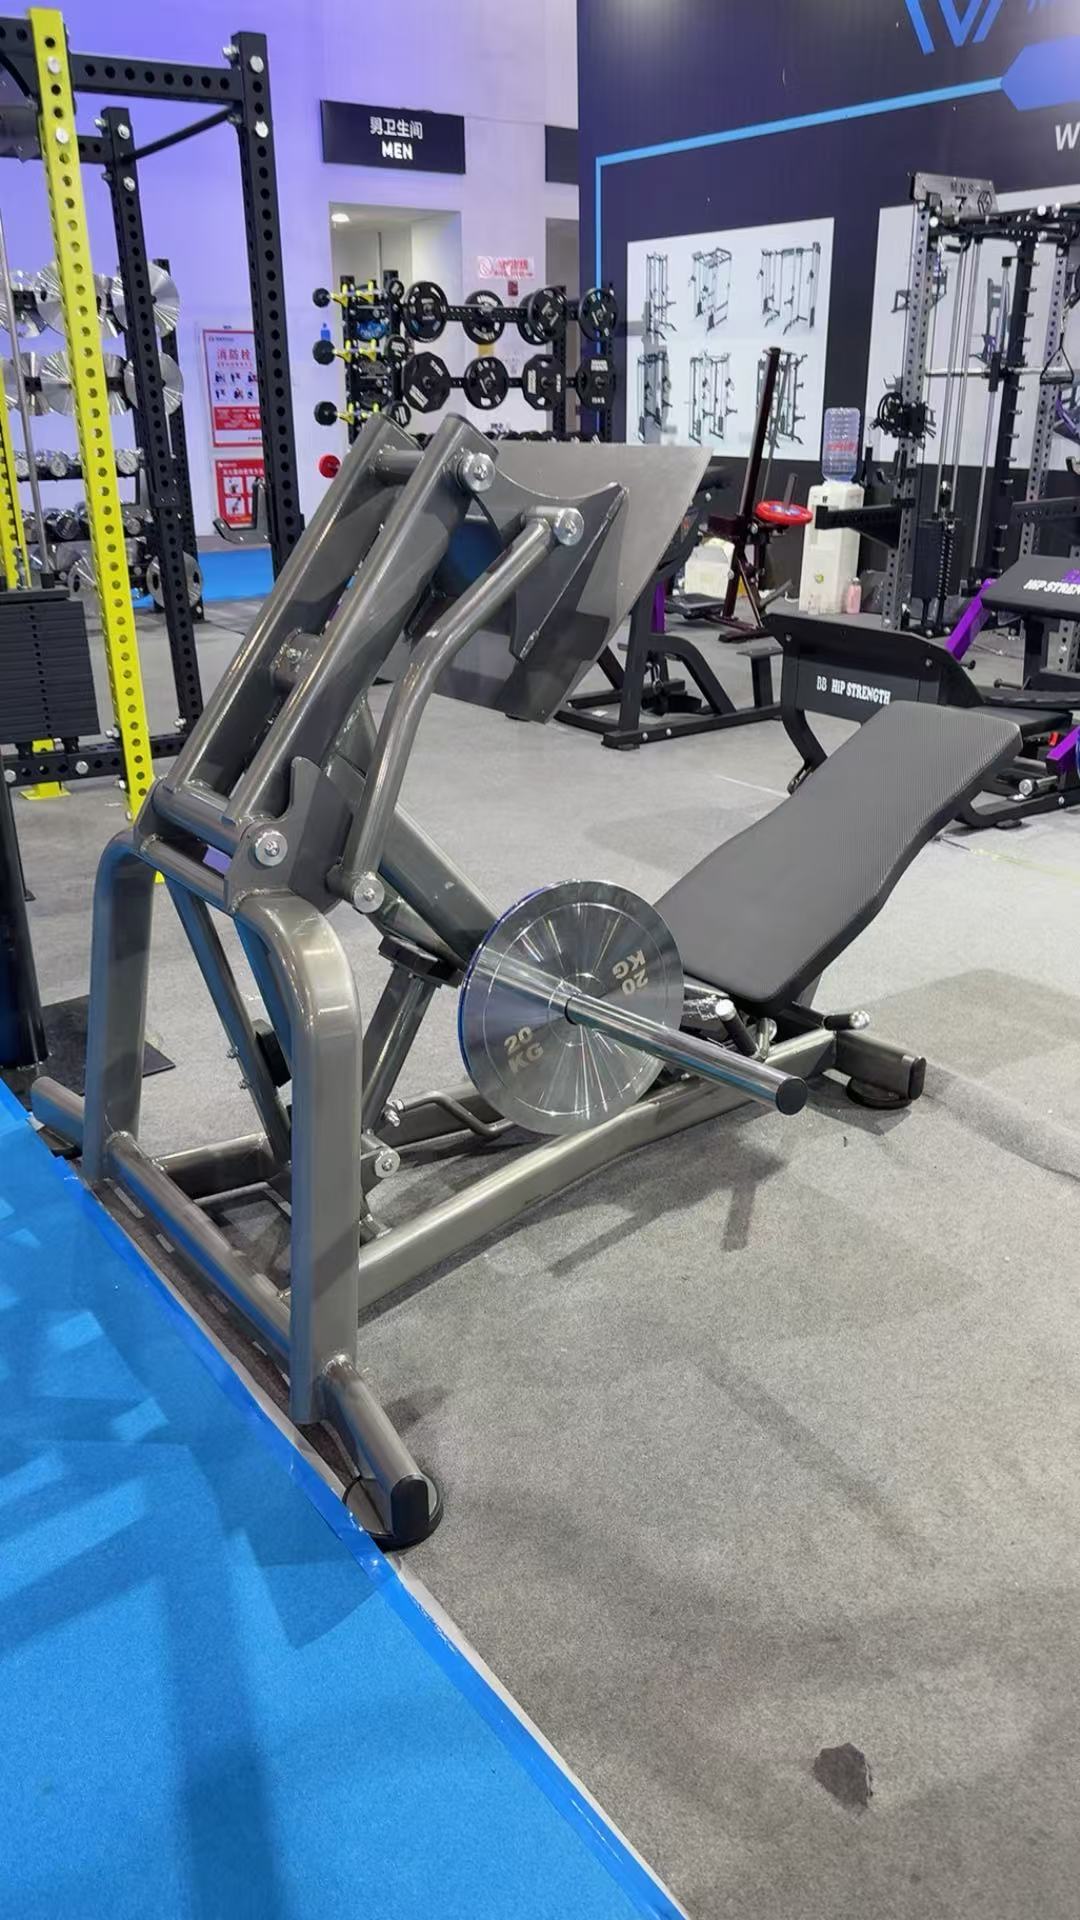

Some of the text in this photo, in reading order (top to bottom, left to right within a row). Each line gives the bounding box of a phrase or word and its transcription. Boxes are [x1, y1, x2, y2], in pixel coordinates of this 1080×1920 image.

[370, 116, 423, 140] 男卫生间
[381, 140, 413, 160] MEN
[846, 681, 891, 705] STRENGTH
[612, 949, 646, 979] KG
[622, 968, 648, 996] 20
[504, 1026, 533, 1053] 20
[508, 1042, 544, 1074] KG
